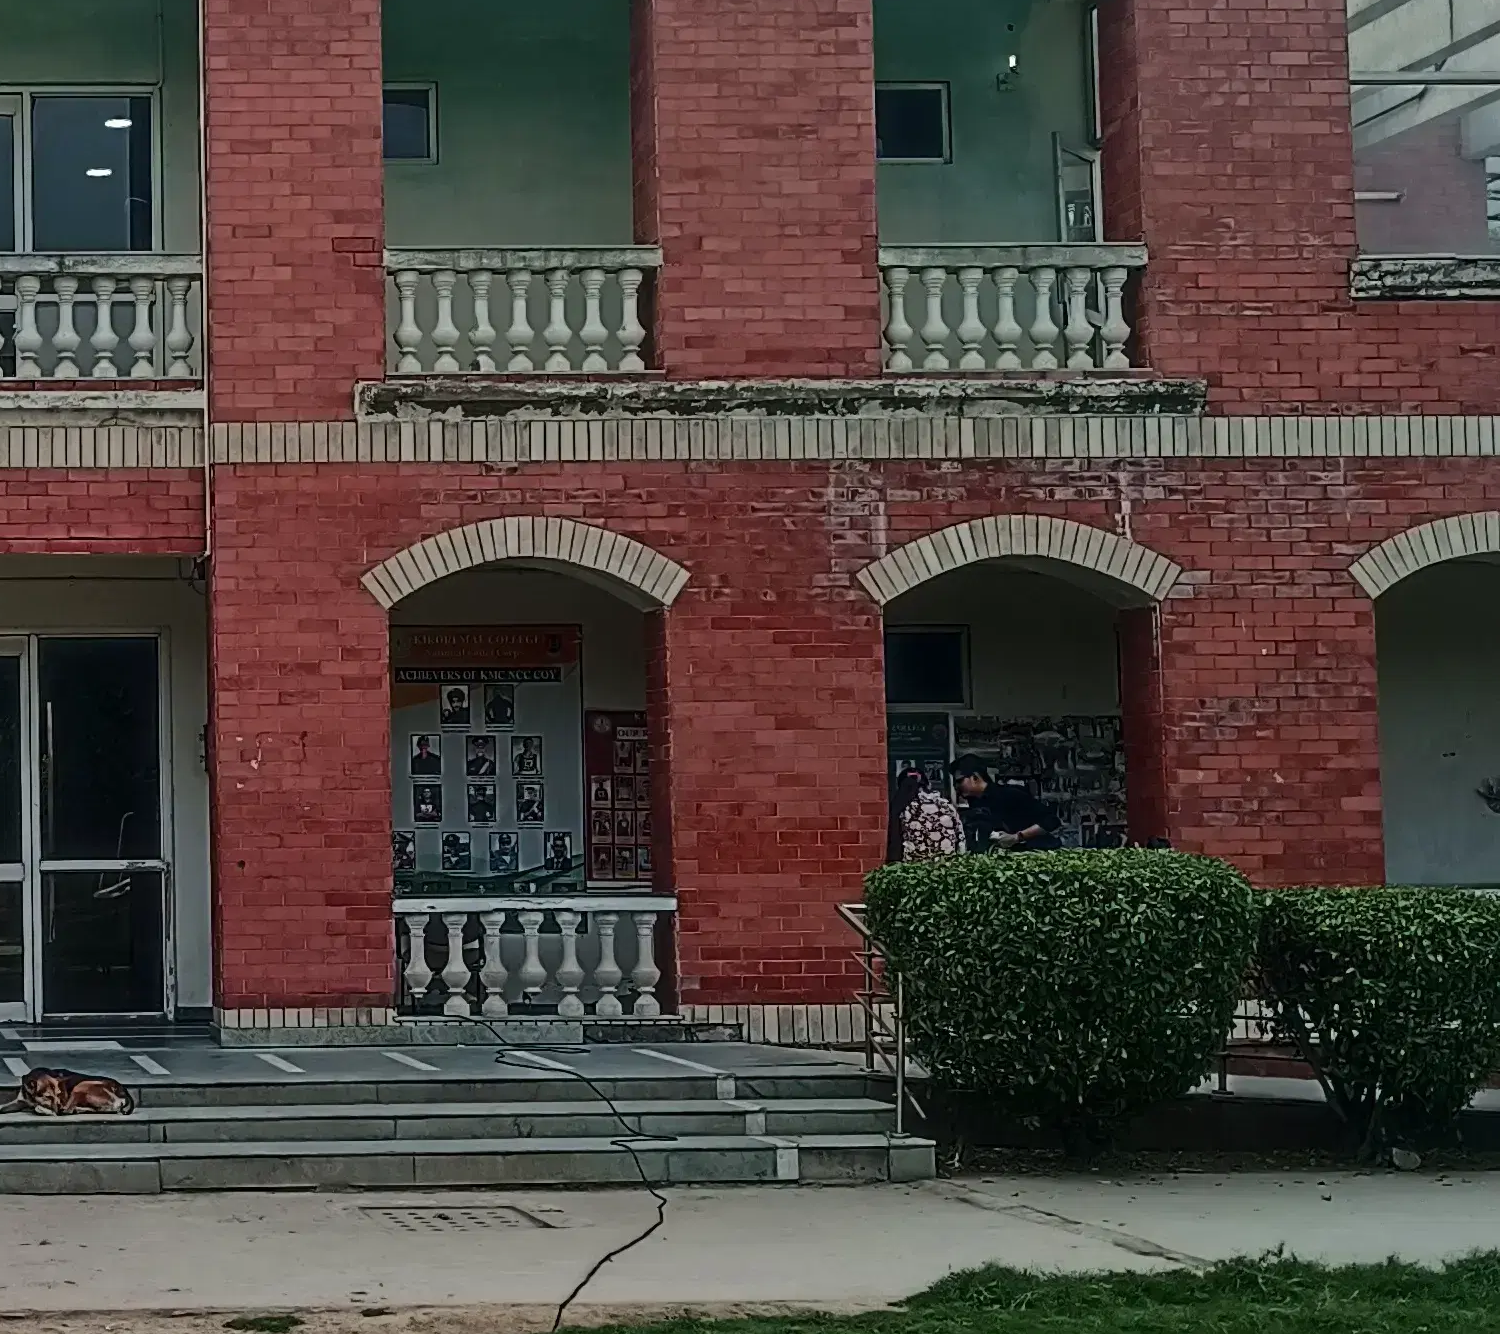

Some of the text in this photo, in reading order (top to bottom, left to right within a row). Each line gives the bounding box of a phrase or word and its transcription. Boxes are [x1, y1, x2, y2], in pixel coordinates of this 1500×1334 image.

[396, 669, 461, 681] ACHIEVERS
[480, 669, 505, 680] KMC
[507, 669, 531, 680] NCC
[533, 669, 557, 680] COY
